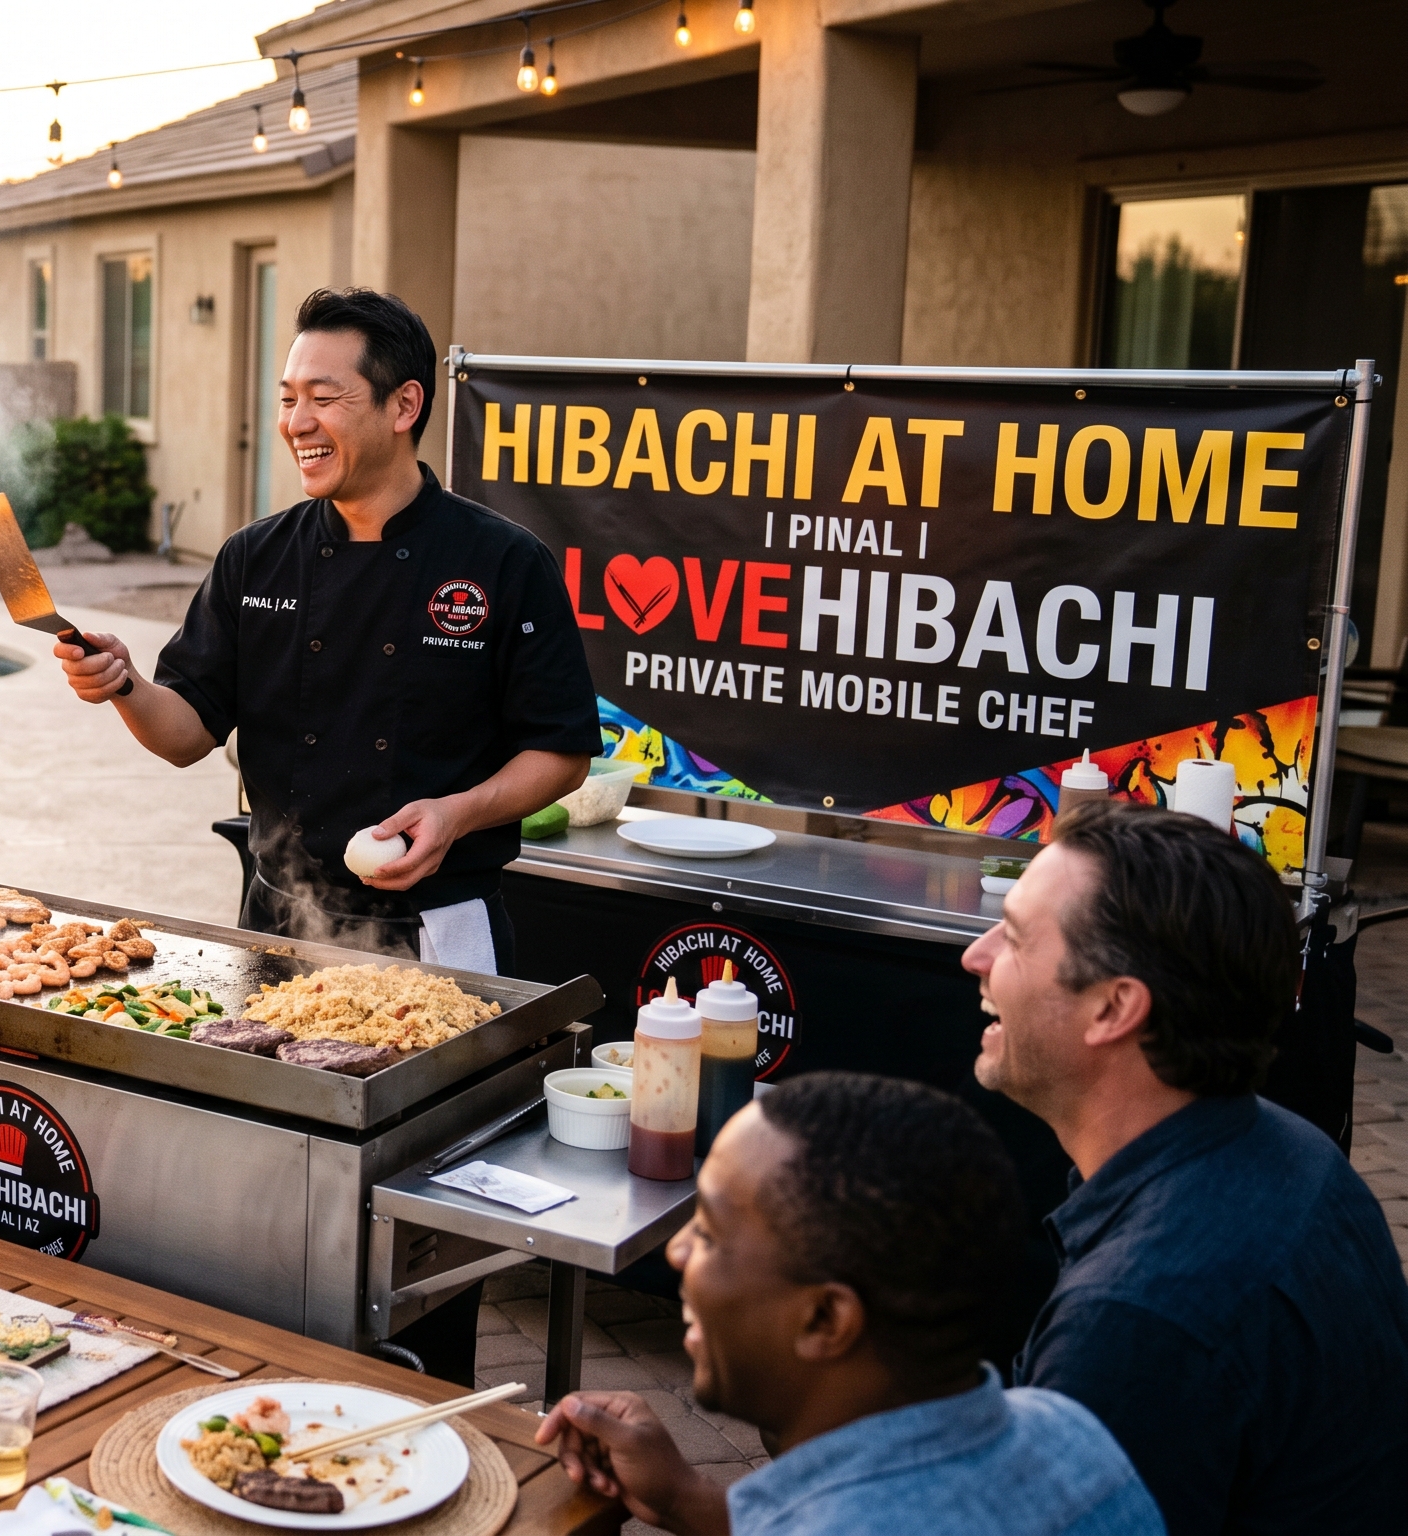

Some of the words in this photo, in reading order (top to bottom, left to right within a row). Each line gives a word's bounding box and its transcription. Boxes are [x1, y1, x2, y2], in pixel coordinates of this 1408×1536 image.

[481, 402, 817, 500] HIBACHI
[841, 416, 965, 508] AT
[992, 422, 1306, 529] HOME
[789, 513, 903, 557] PINAL
[241, 595, 273, 609] PINAL
[280, 598, 297, 610] AZ
[422, 636, 460, 648] PRIVATE
[461, 640, 486, 650] CHEF
[625, 651, 785, 704] PRIVATE
[800, 669, 961, 725] MOBILE
[978, 690, 1095, 739] CHEF
[654, 932, 714, 972] HIBACHI
[718, 934, 742, 953] AT
[743, 946, 783, 994] HOME
[9, 1099, 32, 1123] AT
[33, 1115, 76, 1174] HOME
[24, 1217, 40, 1234] AZ
